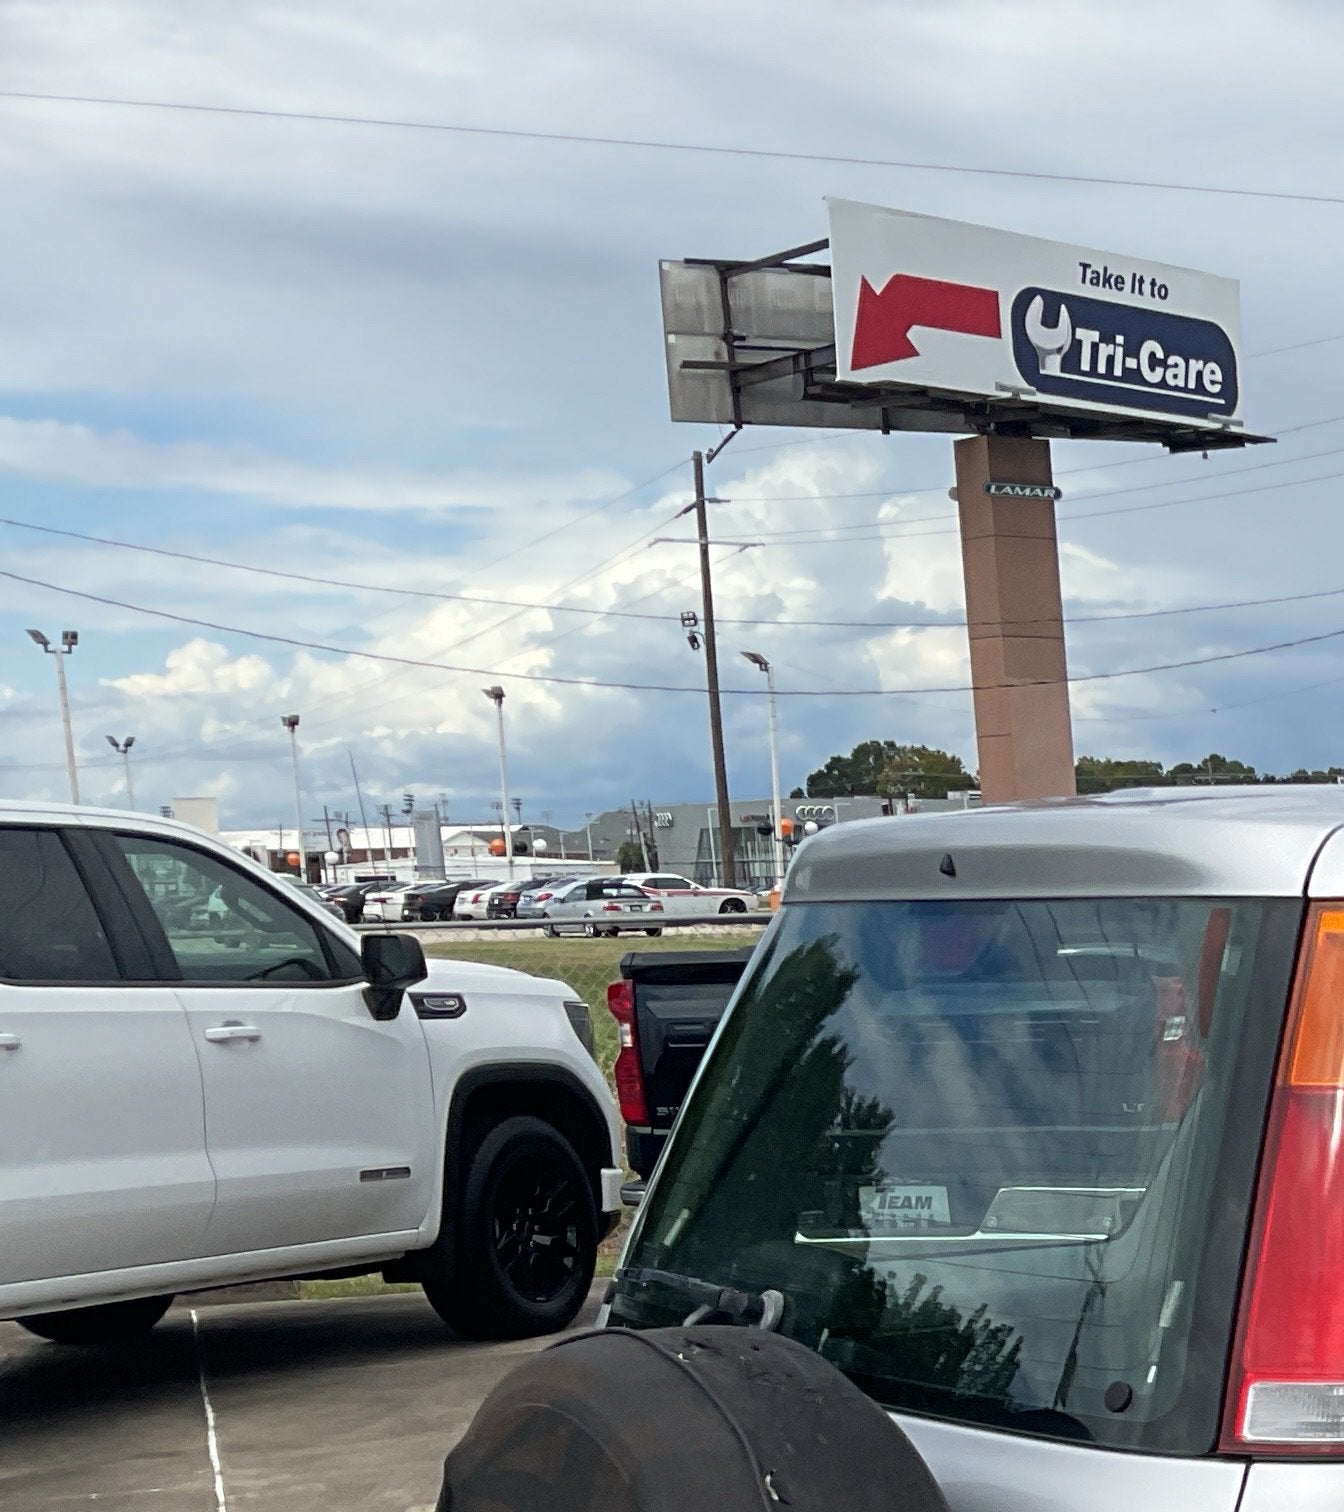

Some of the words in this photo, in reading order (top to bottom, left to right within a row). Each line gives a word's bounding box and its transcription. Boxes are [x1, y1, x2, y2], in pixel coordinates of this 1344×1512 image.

[1079, 262, 1125, 292] Take
[1131, 273, 1145, 296] It
[1150, 278, 1169, 301] to
[1075, 327, 1223, 394] Tri-Care
[990, 485, 1056, 498] LAMAR
[1122, 1103, 1144, 1112] LT
[876, 1188, 932, 1209] TEAM
